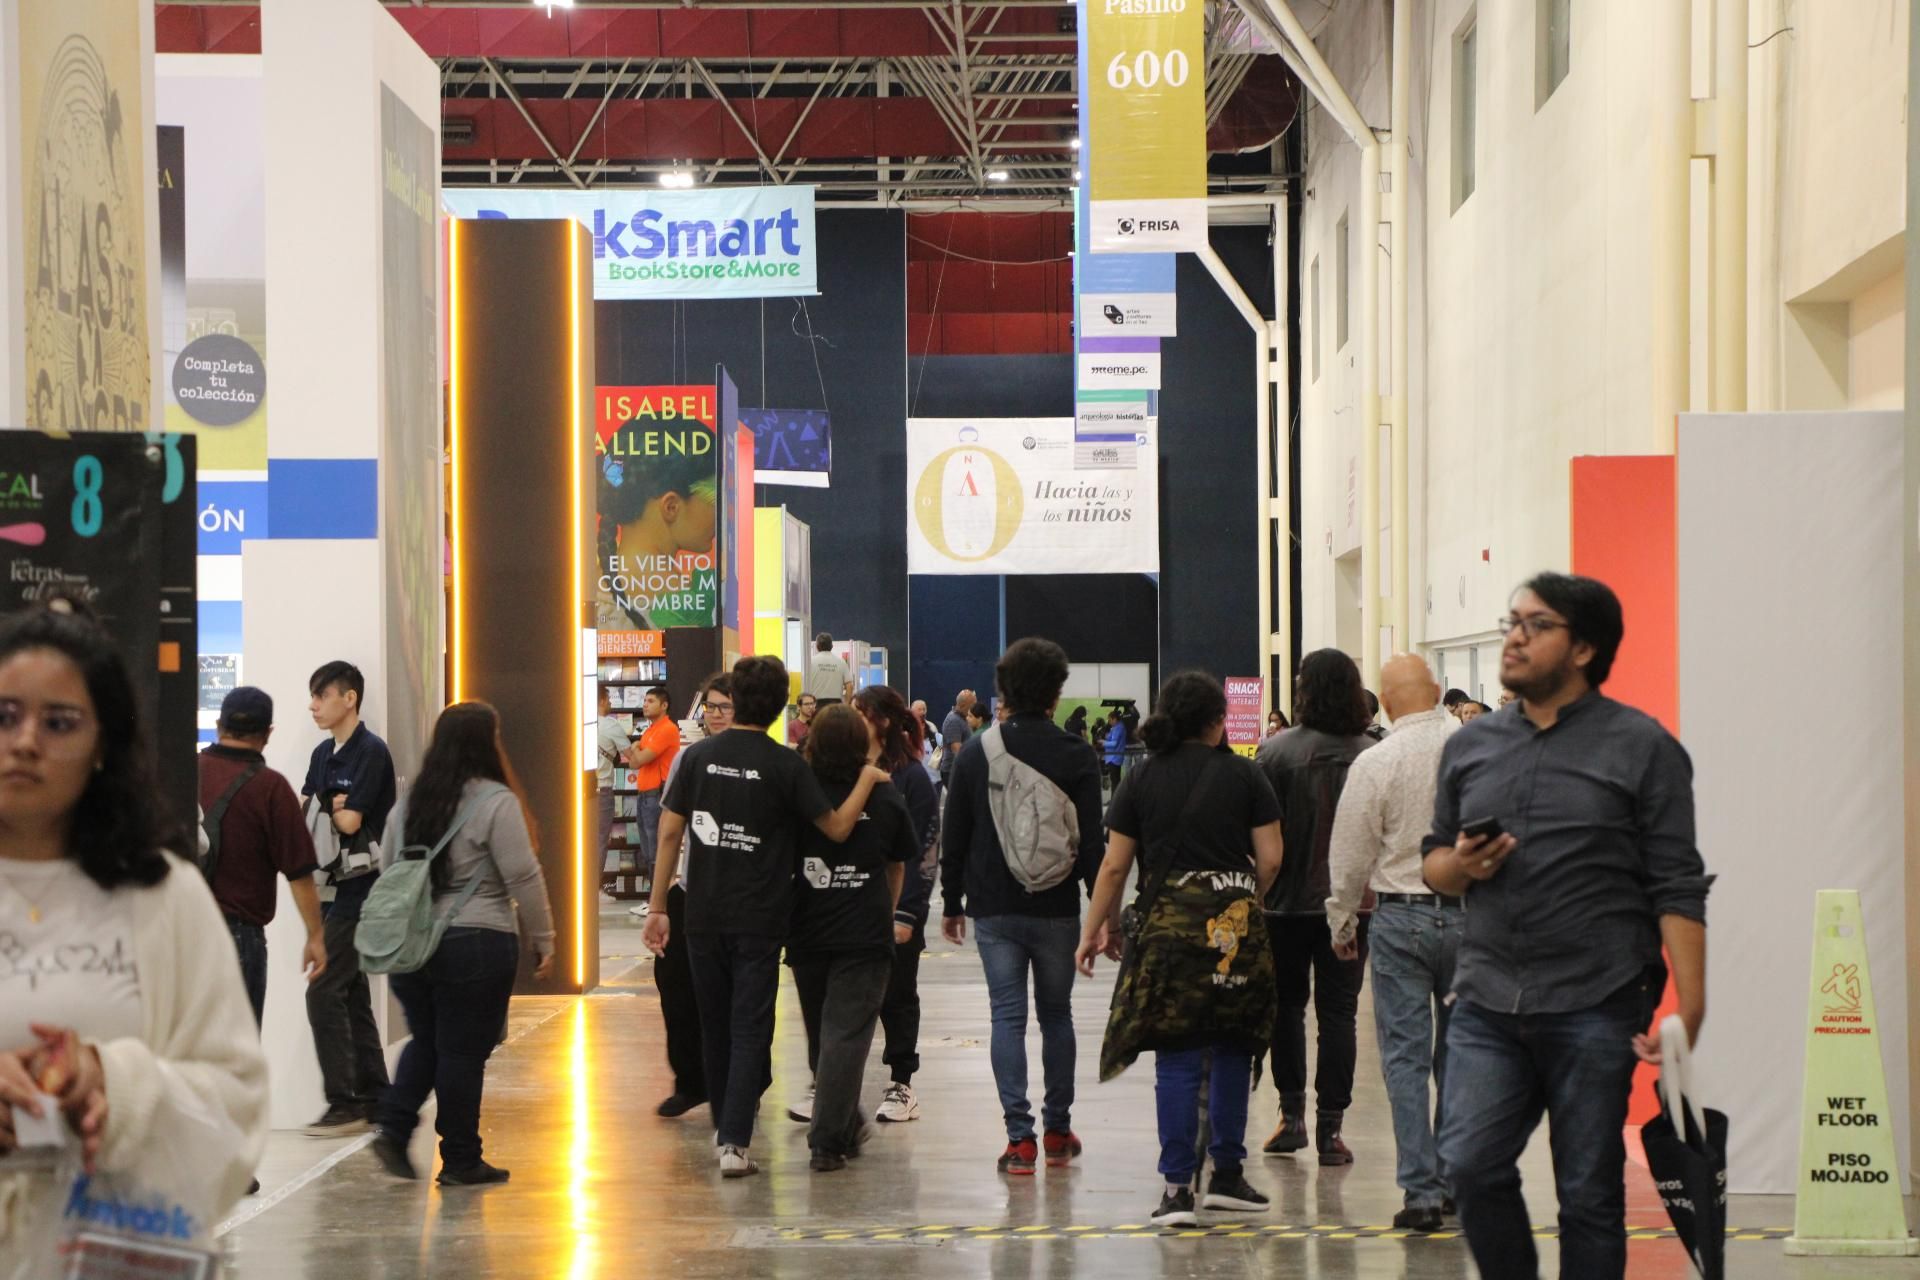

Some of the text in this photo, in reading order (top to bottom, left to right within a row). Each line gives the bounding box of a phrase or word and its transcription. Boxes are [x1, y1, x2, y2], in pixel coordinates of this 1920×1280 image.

[1107, 49, 1189, 89] 600
[1139, 220, 1180, 231] FRISA
[609, 260, 801, 281] BookStore&More
[184, 357, 255, 374] Completa
[209, 374, 228, 387] tu
[179, 386, 256, 403] colección
[605, 395, 713, 420] ISABEL
[595, 431, 711, 456] ALLEND
[71, 454, 104, 537] 8
[1034, 480, 1133, 501] Hacia las y
[198, 503, 245, 532] ÓN
[1043, 501, 1132, 522] los niños
[609, 554, 711, 572] EL VIENTO
[598, 574, 716, 592] CONOCE M
[616, 594, 706, 611] NOMBRE
[598, 643, 650, 654] BIENESTAR
[1228, 682, 1260, 695] SNACK
[1822, 1015, 1862, 1023] CAUTION
[1814, 1026, 1872, 1035] PRECAUCION
[1827, 1097, 1866, 1110] WET
[1818, 1113, 1878, 1126] FLOOR
[1828, 1153, 1871, 1166] PISO
[1811, 1169, 1889, 1184] MOJADO
